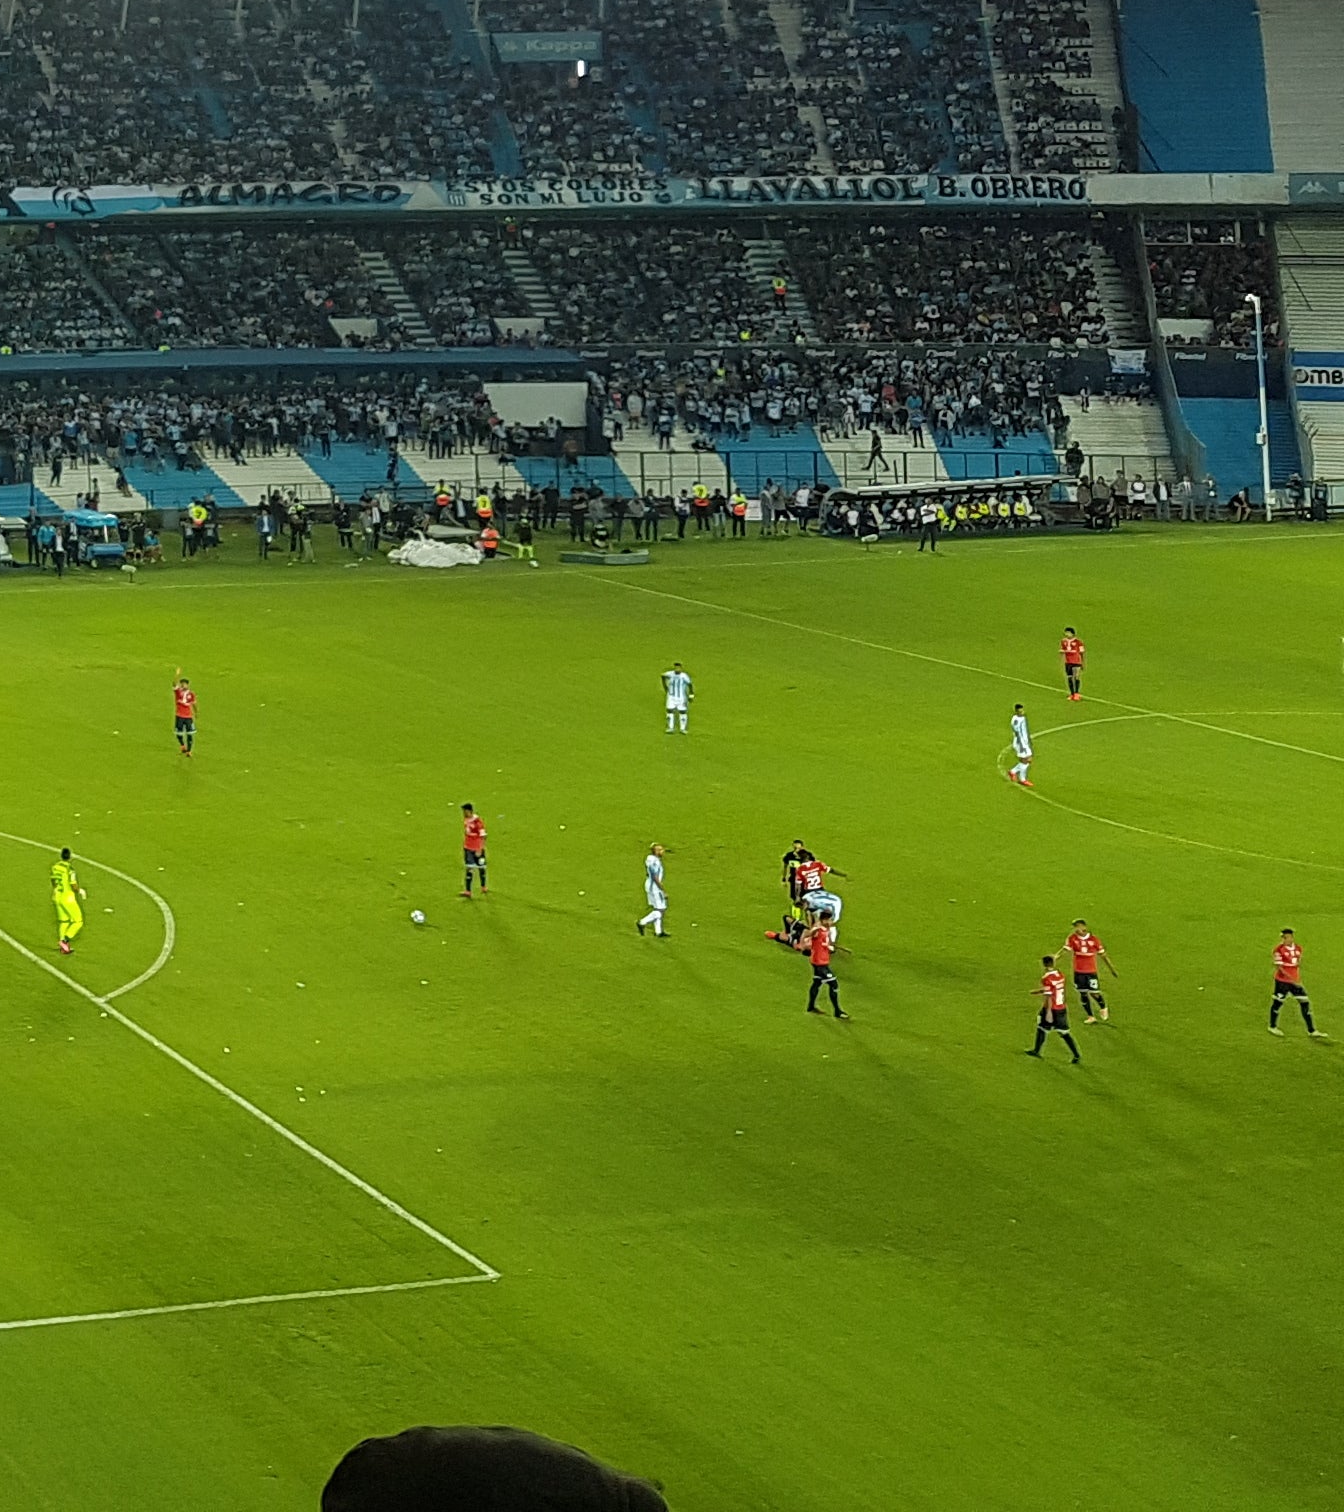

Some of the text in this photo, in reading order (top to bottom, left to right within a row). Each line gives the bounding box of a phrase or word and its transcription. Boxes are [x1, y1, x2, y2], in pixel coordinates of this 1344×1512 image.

[178, 181, 402, 208] ALMAGRO
[446, 177, 669, 194] ESTOS COLORES
[698, 175, 924, 202] LLAVALLOL
[938, 175, 1088, 200] B. OBRERO
[480, 191, 644, 206] SON MI LUJO
